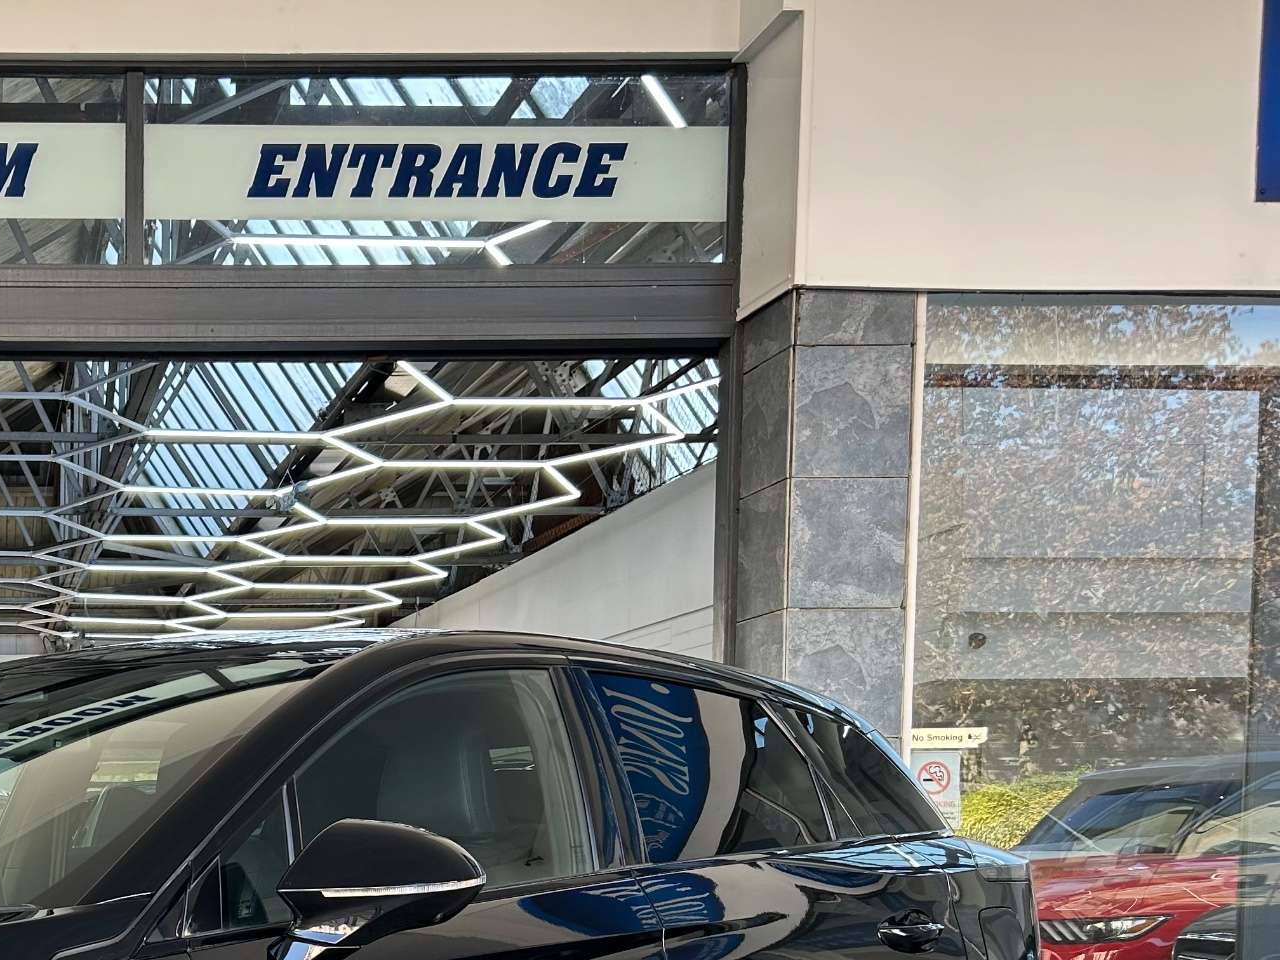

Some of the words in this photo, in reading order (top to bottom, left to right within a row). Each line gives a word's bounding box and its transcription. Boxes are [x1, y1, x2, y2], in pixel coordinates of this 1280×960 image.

[247, 142, 628, 199] ENTRANCE
[912, 734, 924, 742] No
[927, 734, 963, 743] Smoking
